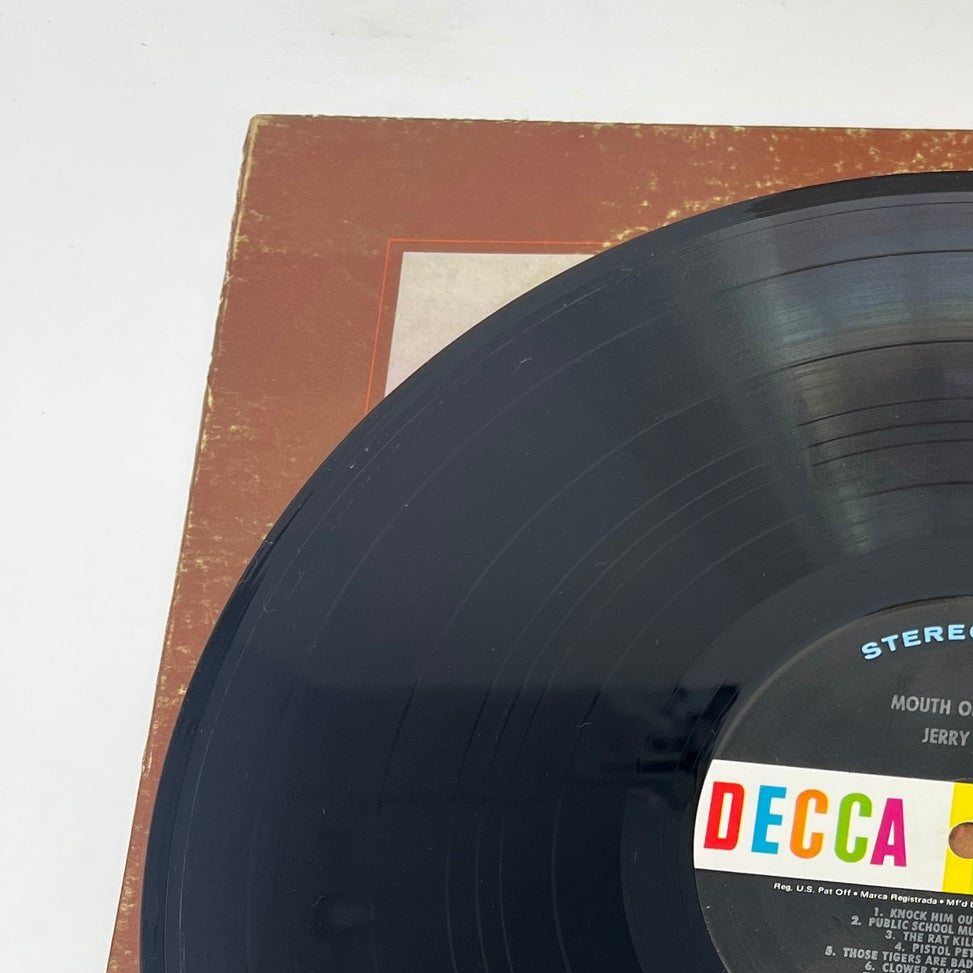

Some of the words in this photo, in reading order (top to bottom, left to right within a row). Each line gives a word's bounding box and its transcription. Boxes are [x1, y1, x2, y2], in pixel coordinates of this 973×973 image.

[891, 695, 951, 715] MOUTH
[922, 728, 970, 746] JERRY
[703, 781, 907, 867] DECCA
[774, 882, 792, 892] Reg.
[797, 885, 815, 893] U.S.
[818, 887, 832, 895] Pat
[836, 888, 851, 896] Off
[860, 891, 887, 900] Marca
[891, 894, 937, 905] Registrada
[874, 907, 883, 916] 1.
[890, 908, 927, 920] KNOCK
[931, 912, 953, 922] HIM
[851, 916, 861, 925] 2.
[869, 918, 908, 930] PUBLIC
[912, 921, 954, 934] SCHOOL
[885, 930, 895, 940] 3.
[903, 932, 923, 942] THE
[928, 934, 949, 944] RAT
[843, 948, 878, 960] THOSE
[883, 952, 921, 964] TIGERS
[925, 956, 947, 967] ARE
[895, 942, 904, 952] 4.
[912, 943, 950, 955] PISTOL
[865, 962, 875, 971] 6.
